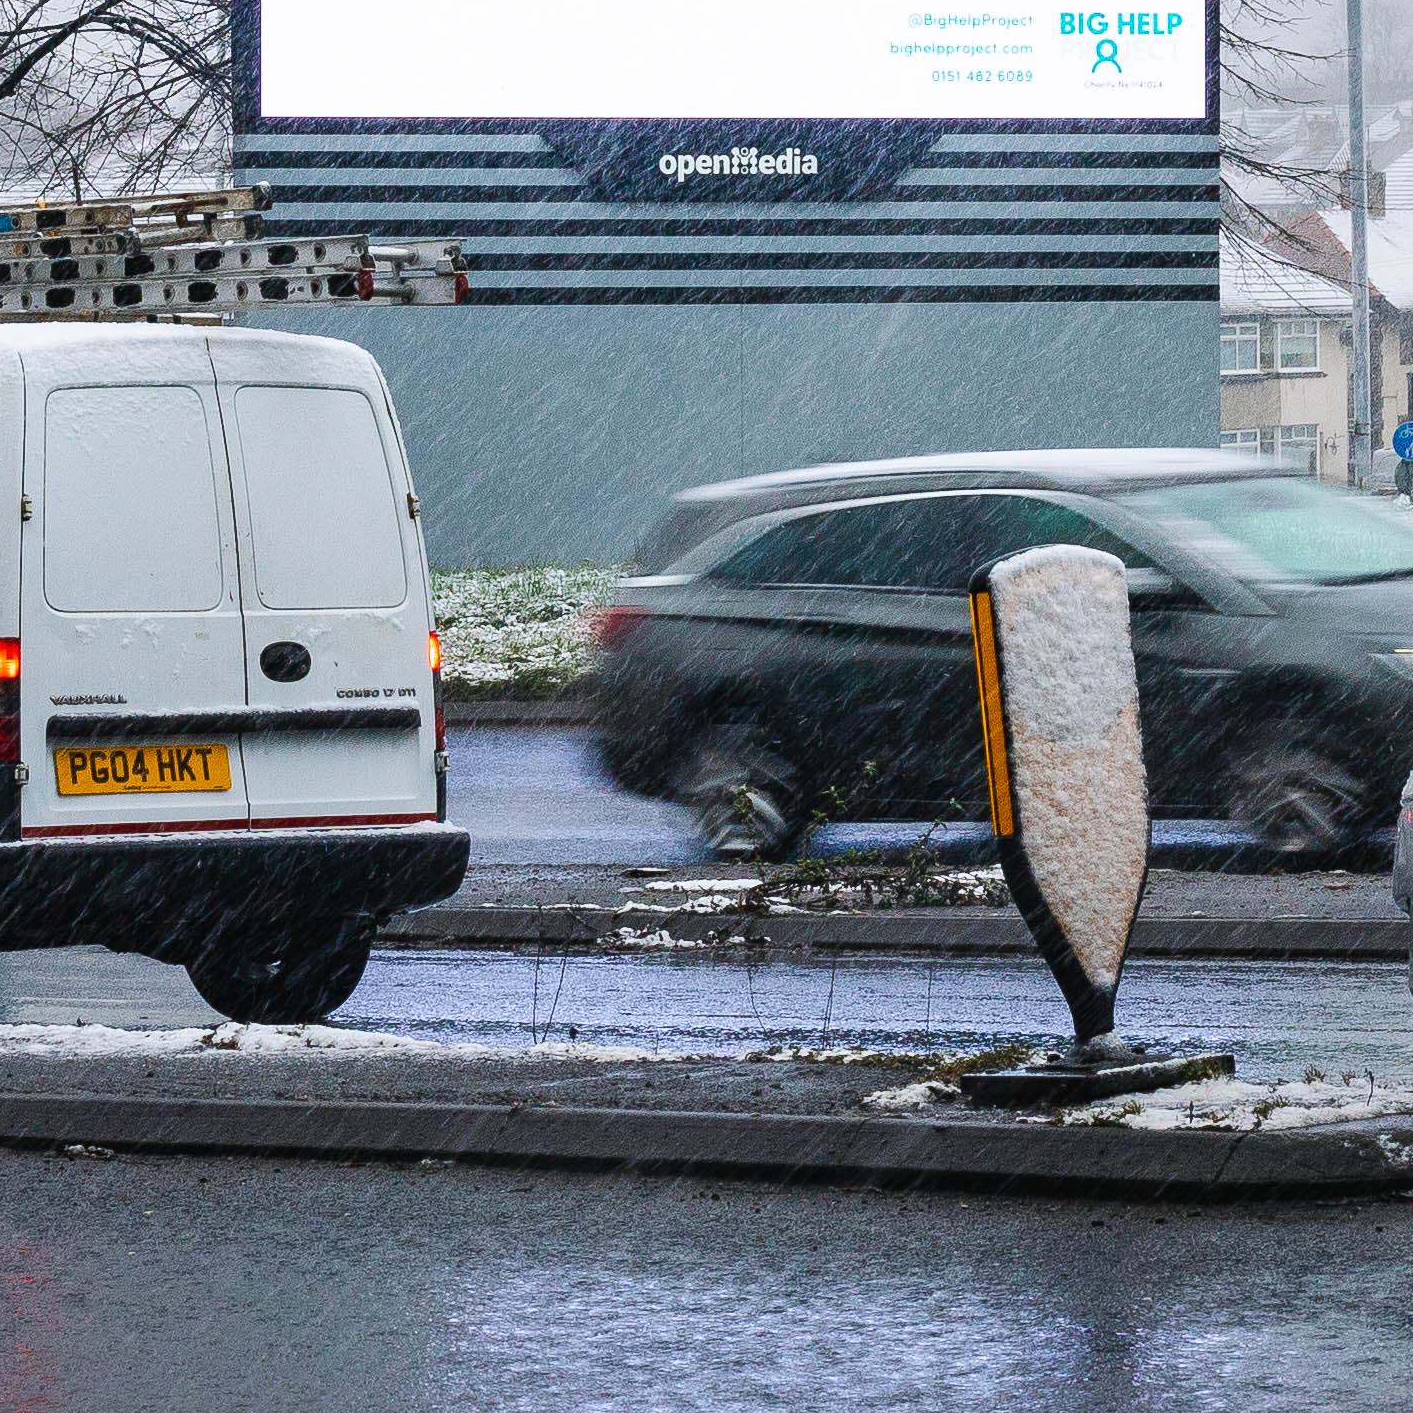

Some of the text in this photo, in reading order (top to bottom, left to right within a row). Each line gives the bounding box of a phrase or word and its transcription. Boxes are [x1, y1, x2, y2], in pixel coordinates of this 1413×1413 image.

[1060, 12, 1183, 35] BIG HELP
[931, 70, 961, 83] 0151
[49, 693, 128, 706] VAUXHALL
[69, 747, 213, 785] PG04 HKT
